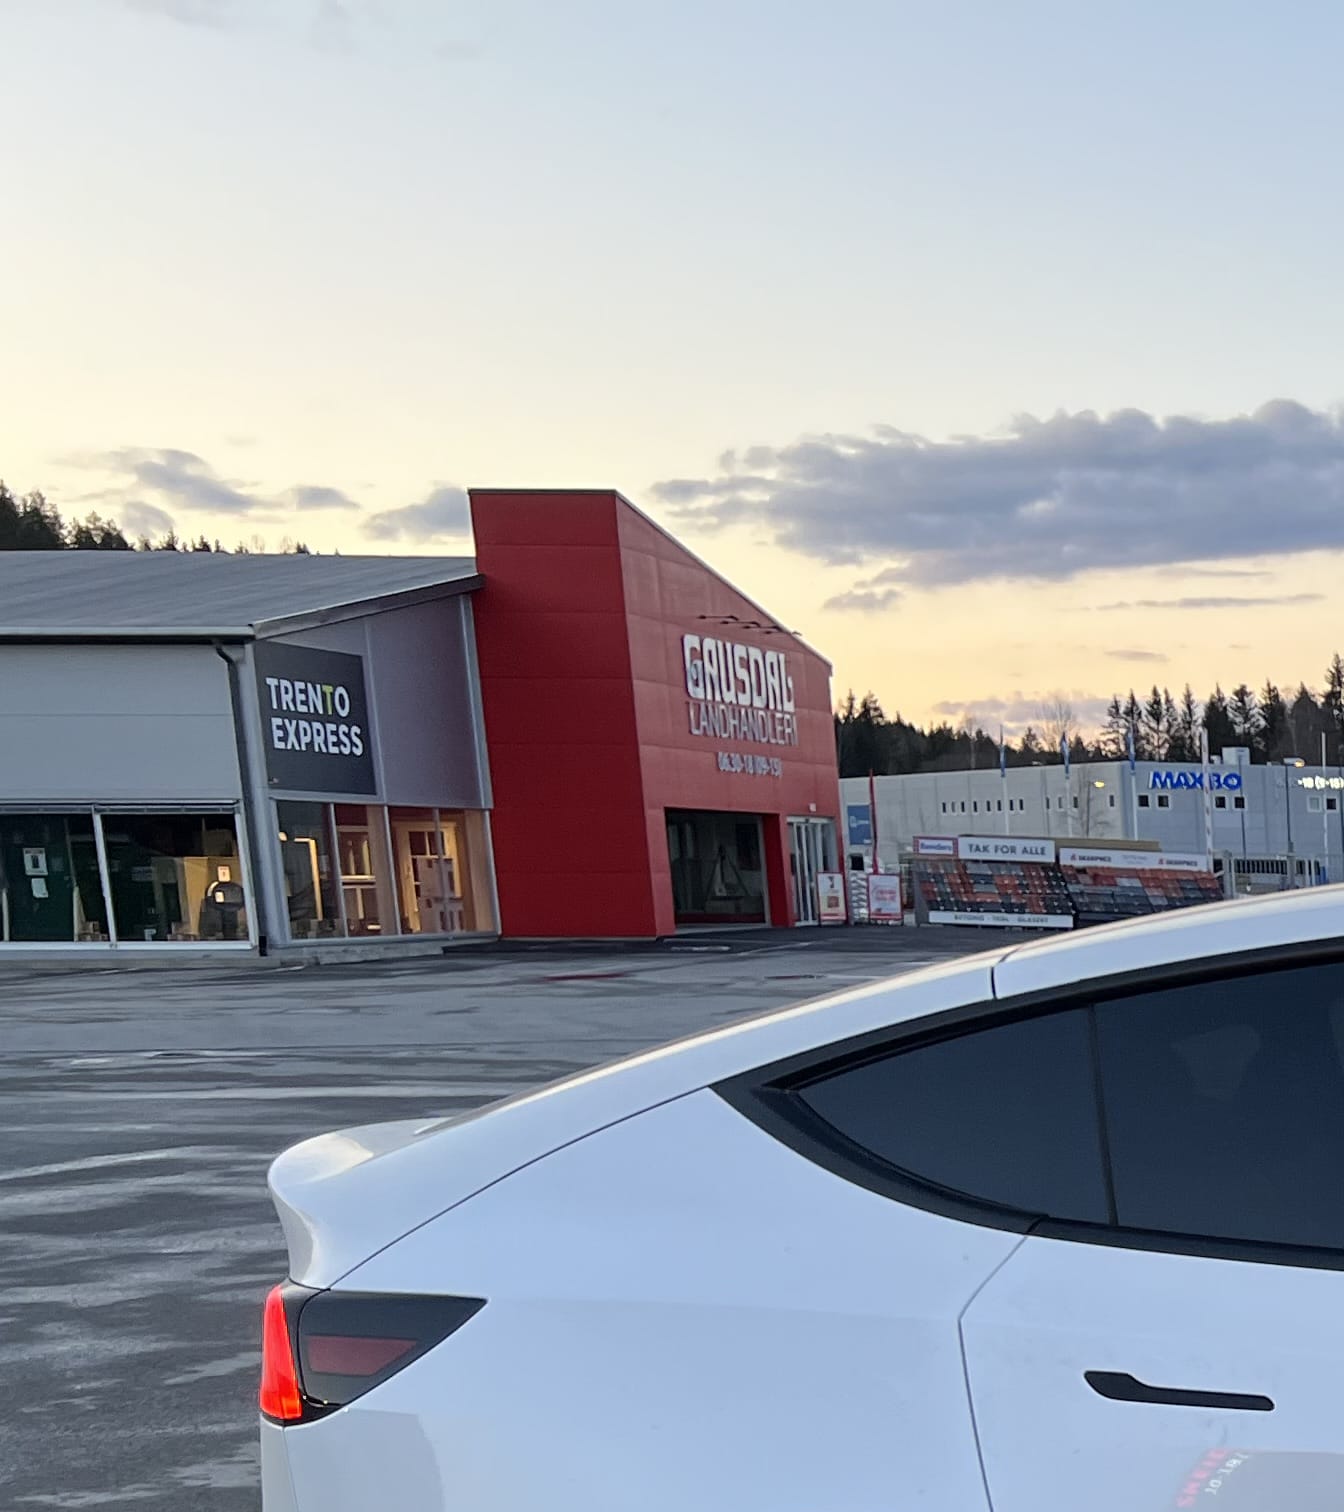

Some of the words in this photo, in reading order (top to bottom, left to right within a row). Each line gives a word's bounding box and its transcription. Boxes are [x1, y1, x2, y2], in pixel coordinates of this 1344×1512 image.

[683, 633, 795, 713] GAUSDAL
[265, 677, 350, 717] TRENTO
[271, 717, 363, 756] EXPRESS
[688, 701, 799, 746] LANDHANDLERI
[1150, 771, 1242, 790] MAXBO
[968, 843, 990, 854] TAK
[994, 844, 1017, 855] FOR
[1021, 846, 1046, 856] ALLE
